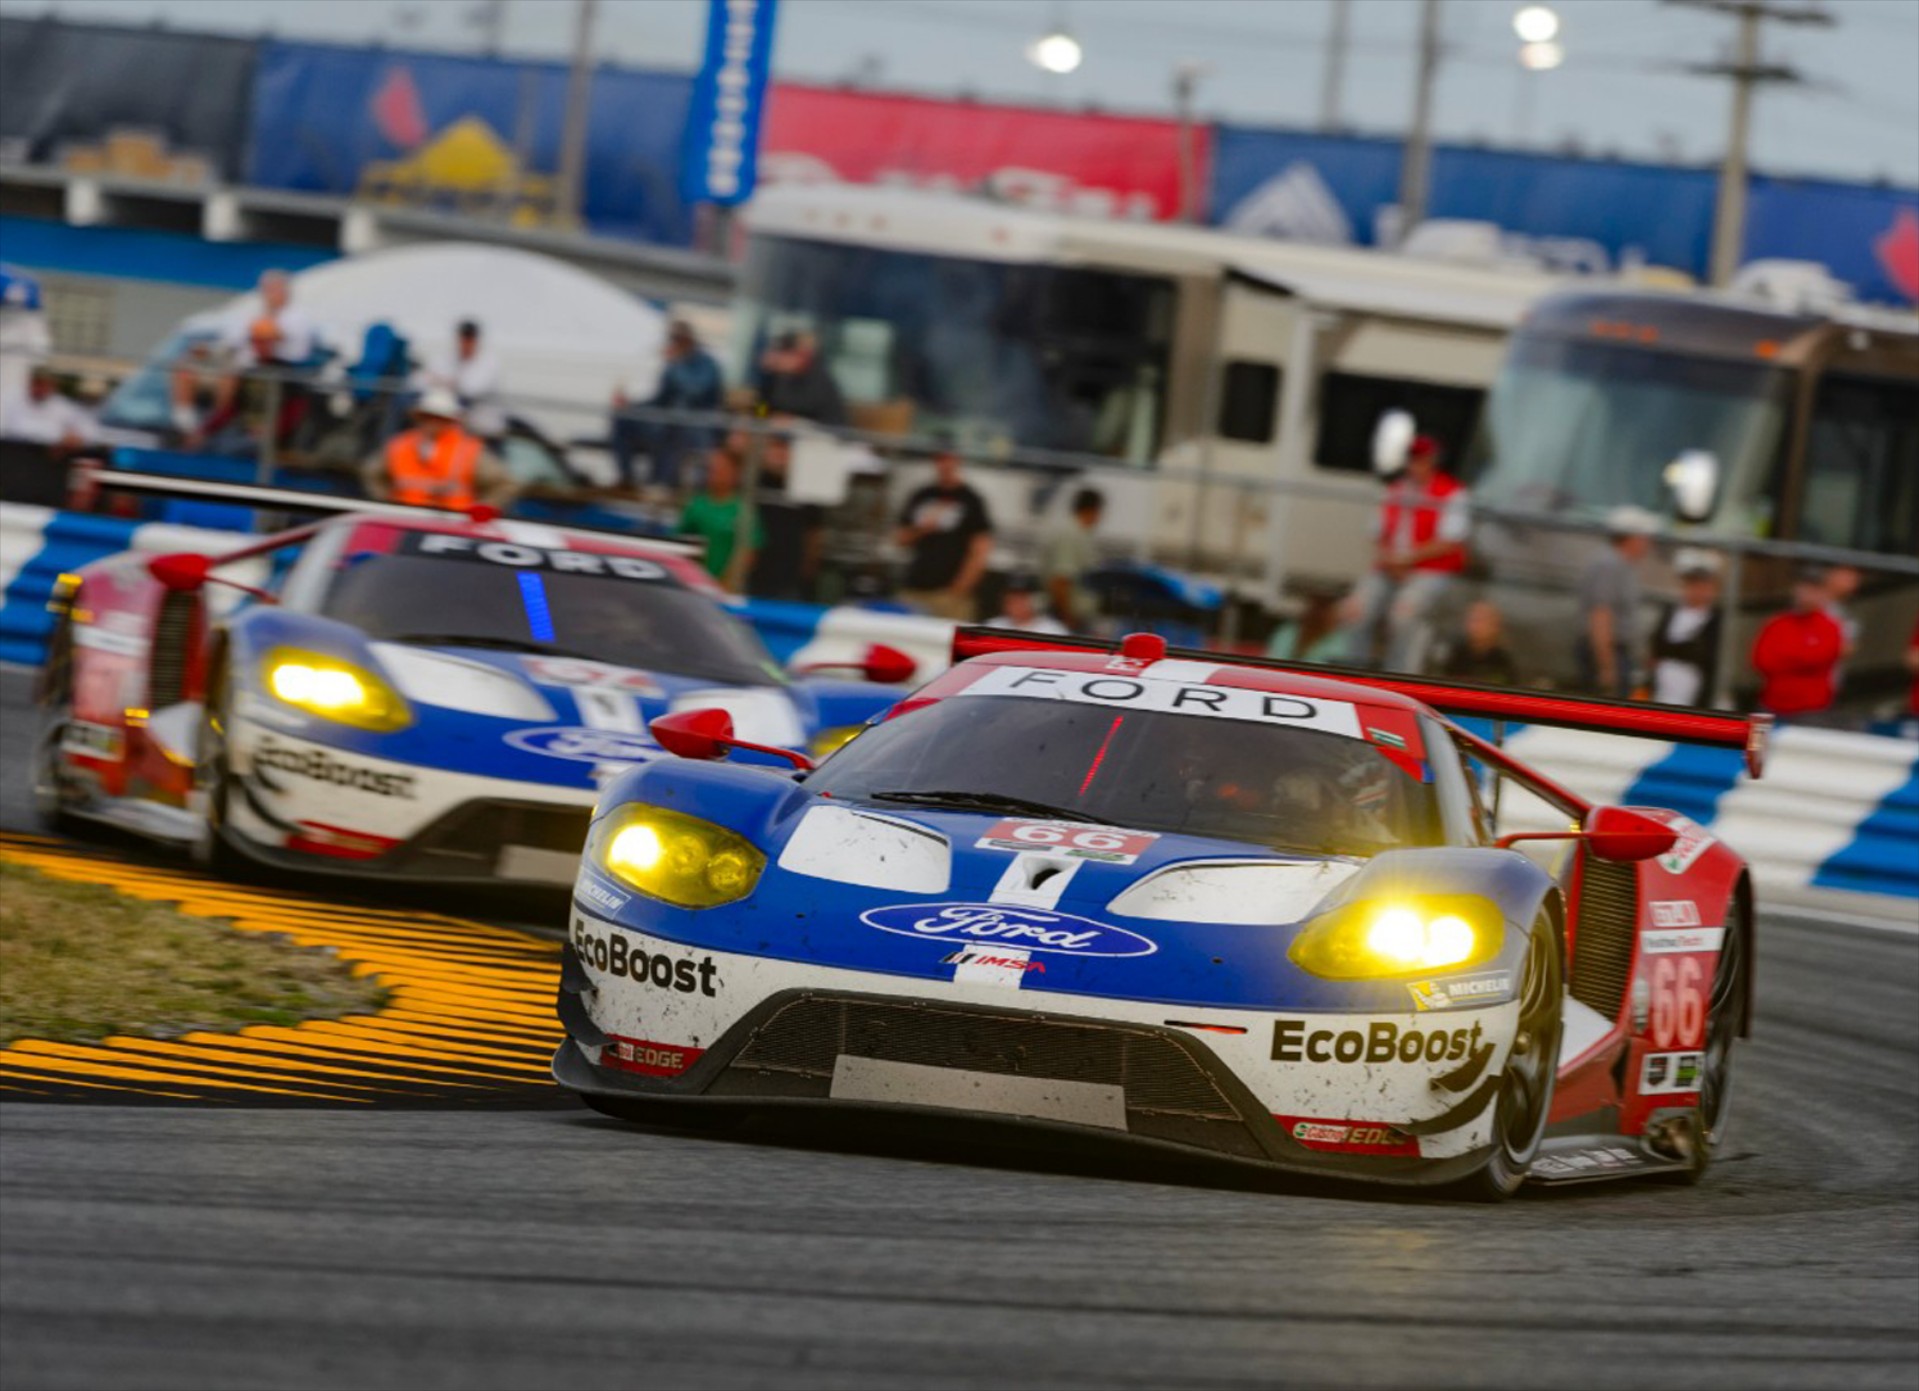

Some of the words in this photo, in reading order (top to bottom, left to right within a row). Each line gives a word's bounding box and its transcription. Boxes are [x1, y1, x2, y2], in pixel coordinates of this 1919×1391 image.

[419, 533, 668, 580] FORD
[1008, 671, 1317, 720] FORD
[1012, 824, 1128, 850] 66
[913, 907, 1101, 948] Ford
[575, 917, 717, 998] EcoBoost
[1652, 956, 1703, 1049] 66
[635, 1046, 684, 1070] EDGE
[1270, 1018, 1484, 1064] EcoBoost
